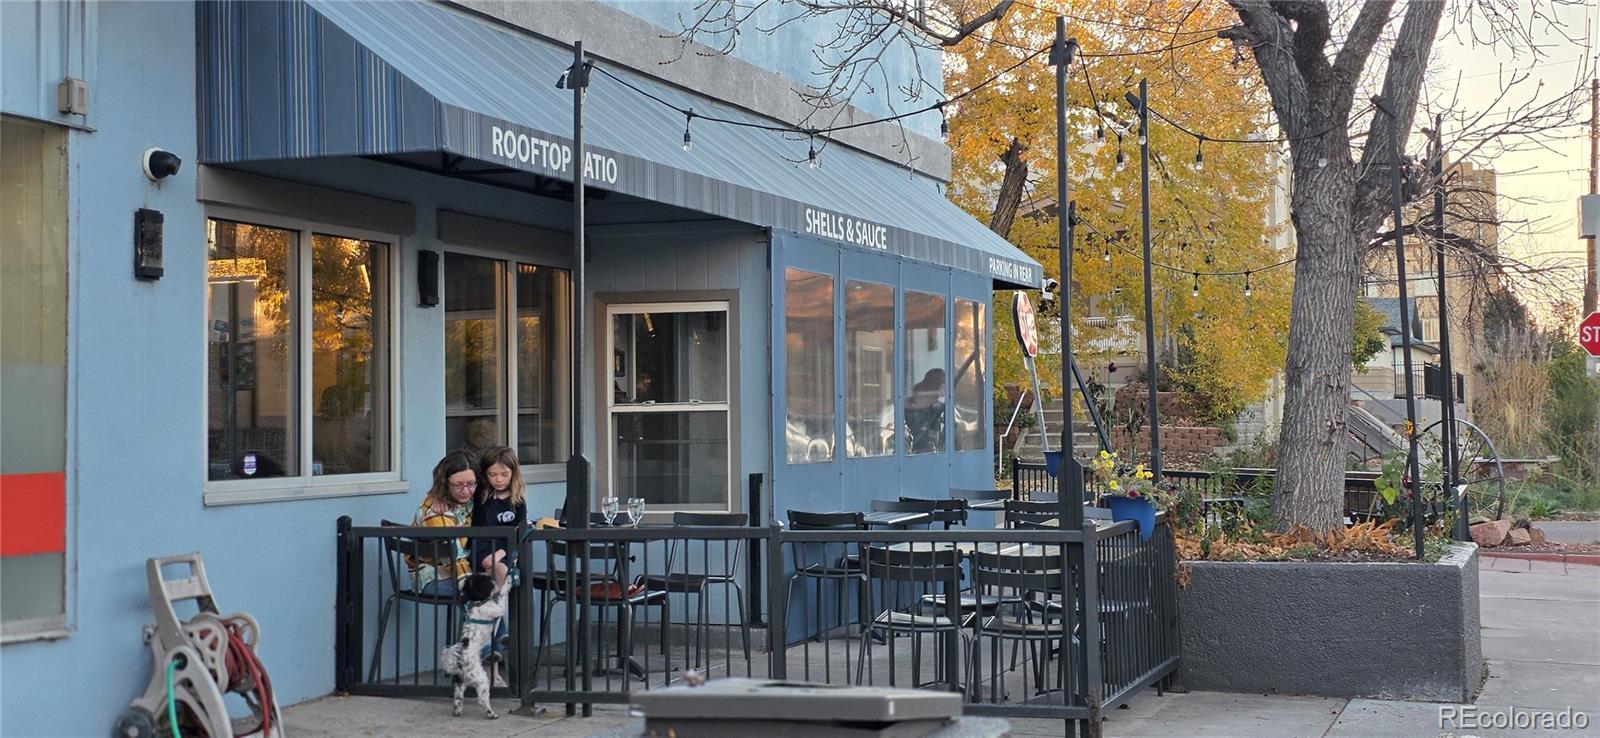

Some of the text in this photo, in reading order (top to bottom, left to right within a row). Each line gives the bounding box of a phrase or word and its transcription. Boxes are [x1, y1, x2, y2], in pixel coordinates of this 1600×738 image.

[492, 126, 617, 184] ROOFTOP ATIO
[805, 208, 887, 250] SHELLS & SAUCE
[989, 257, 1032, 283] PARKING IN REAR
